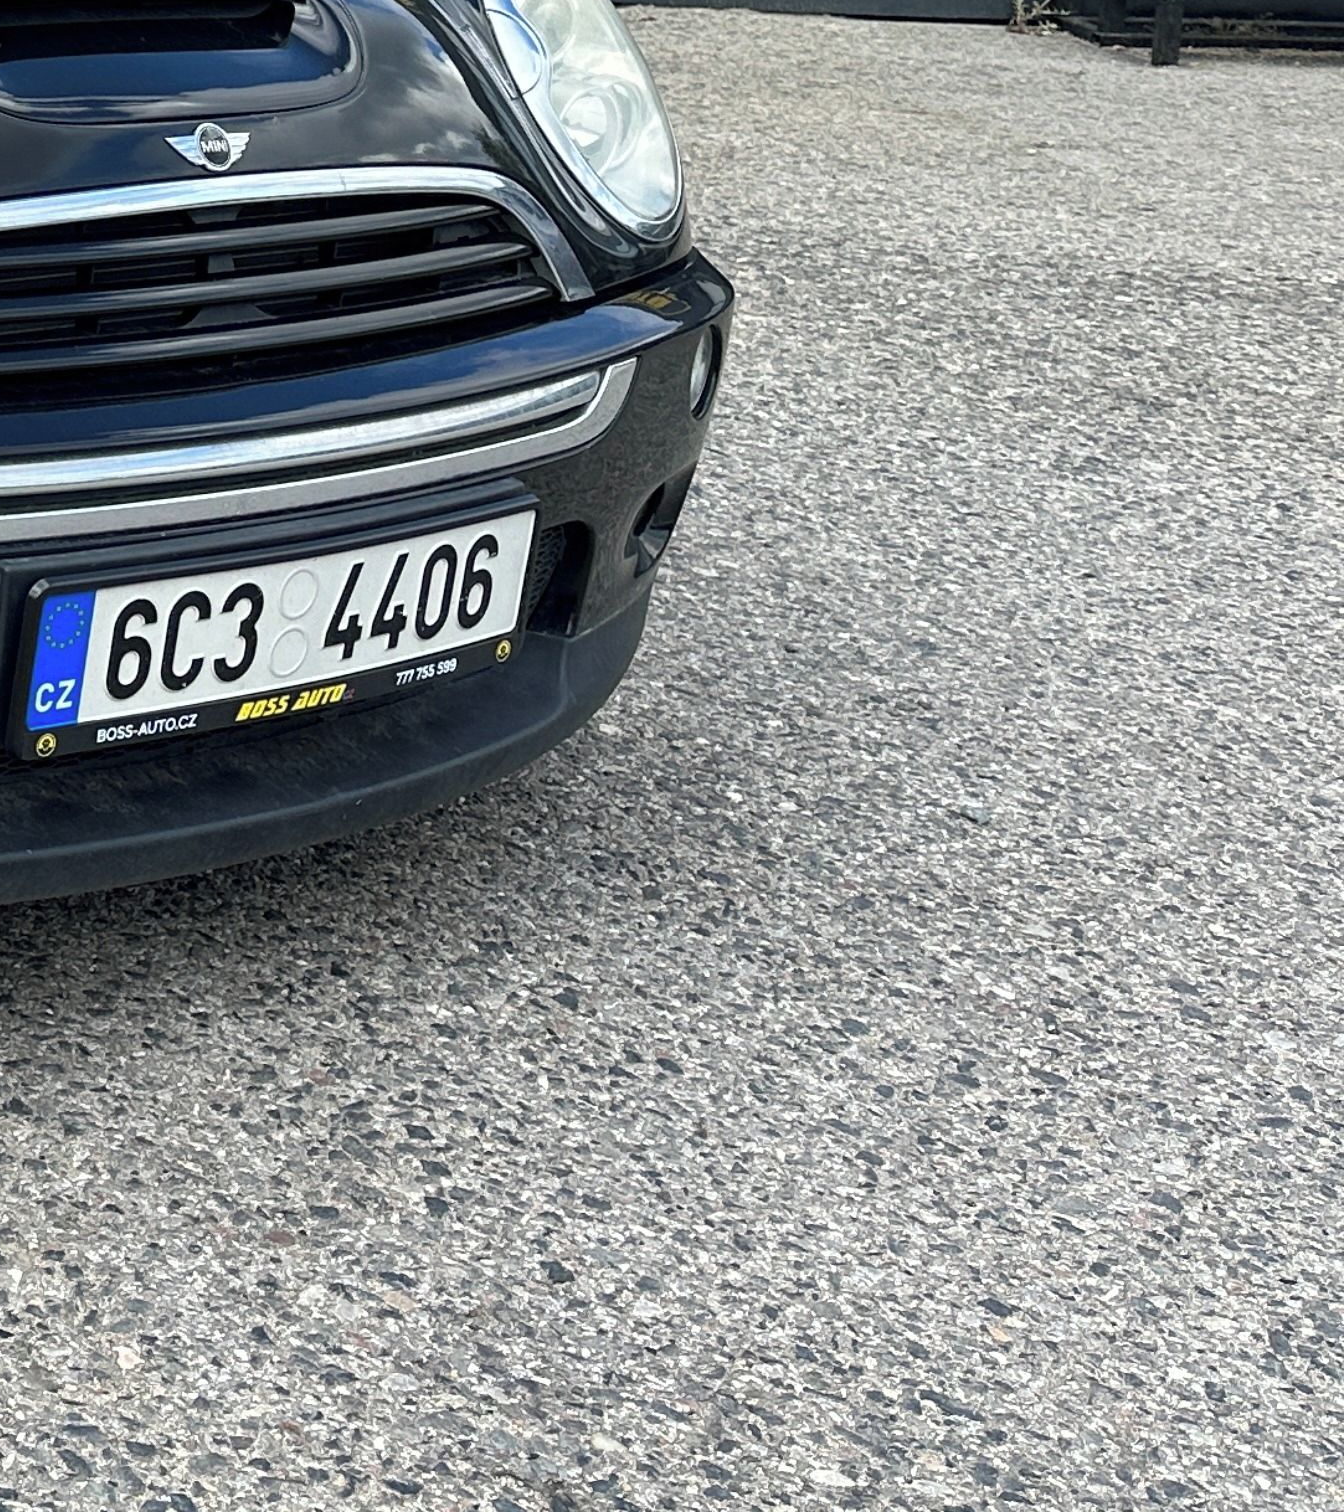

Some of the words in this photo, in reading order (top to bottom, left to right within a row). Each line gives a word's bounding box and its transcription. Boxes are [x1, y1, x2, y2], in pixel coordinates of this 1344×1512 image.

[200, 139, 229, 154] MINI
[105, 583, 265, 700] 6C3
[322, 534, 499, 660] 4406
[35, 679, 76, 713] CZ
[96, 713, 198, 743] BOSS-AUTO.CZ
[235, 694, 289, 723] BOSS
[292, 684, 347, 713] AUTO
[395, 669, 414, 687] 777
[415, 664, 435, 682] 755
